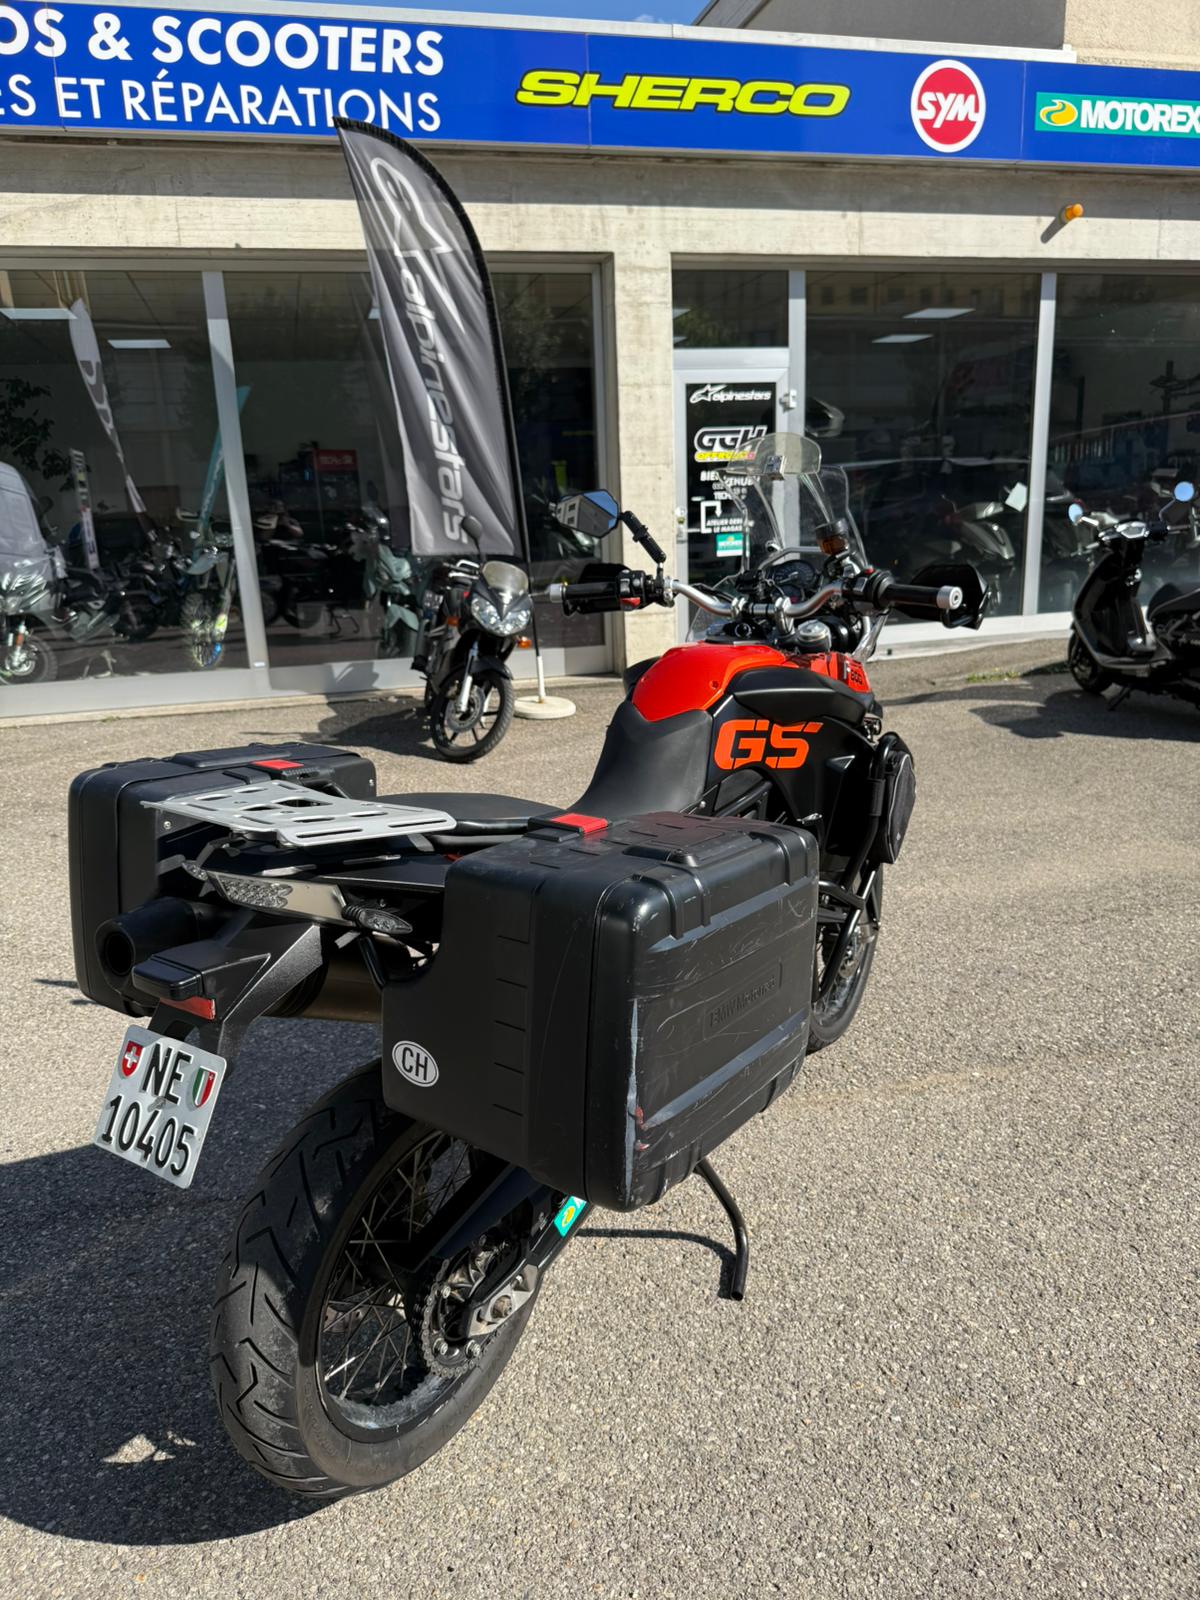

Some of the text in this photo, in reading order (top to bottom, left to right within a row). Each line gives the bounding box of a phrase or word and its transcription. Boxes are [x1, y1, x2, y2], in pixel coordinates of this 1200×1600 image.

[88, 12, 133, 61] &
[152, 15, 444, 76] SCOOTERS
[0, 68, 441, 132] S ET RÉPARATIONS
[516, 69, 851, 118] SHERCO
[916, 91, 979, 129] SYM
[1080, 99, 1200, 134] MOTOREX
[400, 267, 470, 545] alpinestars
[714, 719, 824, 769] GS
[141, 1043, 194, 1105] NE
[402, 1046, 428, 1081] CH
[101, 1094, 197, 1177] 10405
